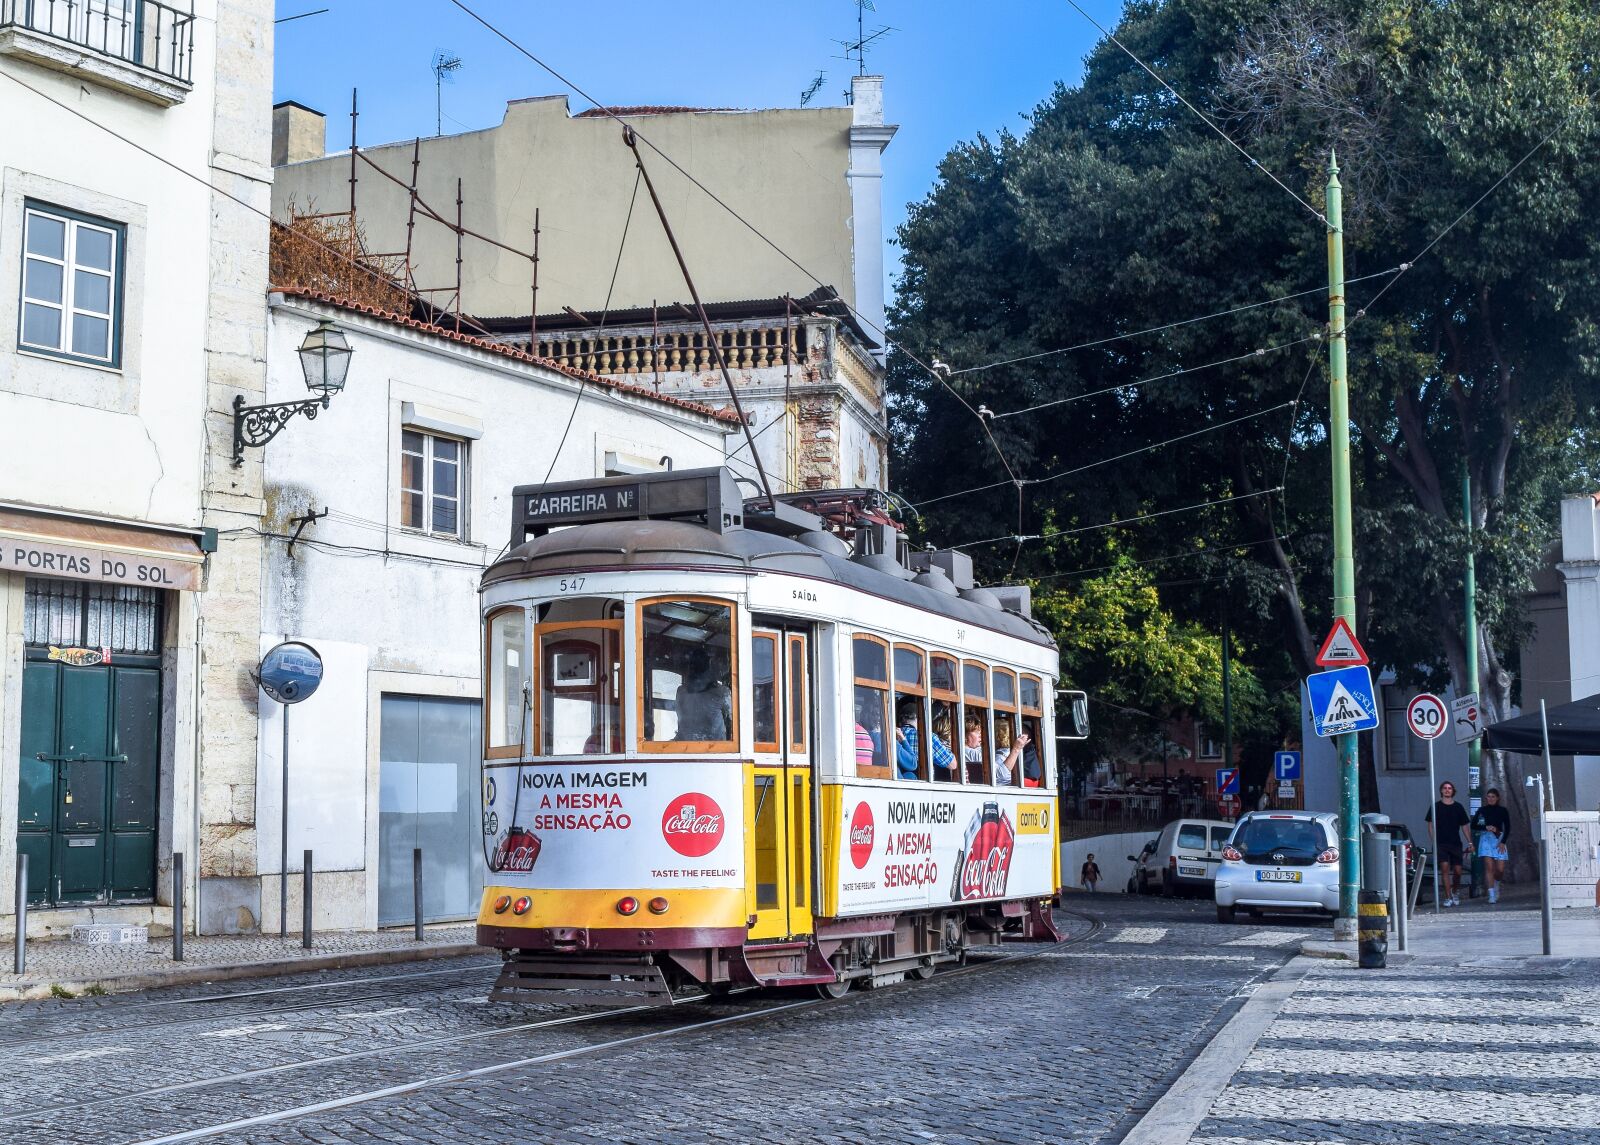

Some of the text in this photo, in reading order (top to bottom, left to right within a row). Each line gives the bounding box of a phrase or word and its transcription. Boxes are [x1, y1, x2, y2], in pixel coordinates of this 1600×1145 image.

[528, 493, 607, 516] CARREIRA
[14, 548, 91, 574] PORTAS
[101, 559, 127, 579] DO
[137, 565, 174, 584] SOL
[560, 577, 586, 592] 547
[792, 589, 818, 603] SAÍDA
[1413, 707, 1440, 726] 30
[1280, 754, 1296, 778] P
[522, 771, 648, 789] NOVA IMAGEM
[539, 792, 622, 809] A MESMA
[534, 809, 631, 833] SENSAÇÃO
[887, 801, 956, 824] NOVA IMAGEM
[1020, 808, 1038, 827] carris
[664, 814, 722, 834] Coca-Cola
[885, 832, 932, 856] A MESMA
[651, 869, 736, 878] TASTE THE FEELING
[884, 857, 938, 889] SENSAÇÃO
[842, 883, 854, 892] TASTE
[861, 881, 876, 890] FEELING
